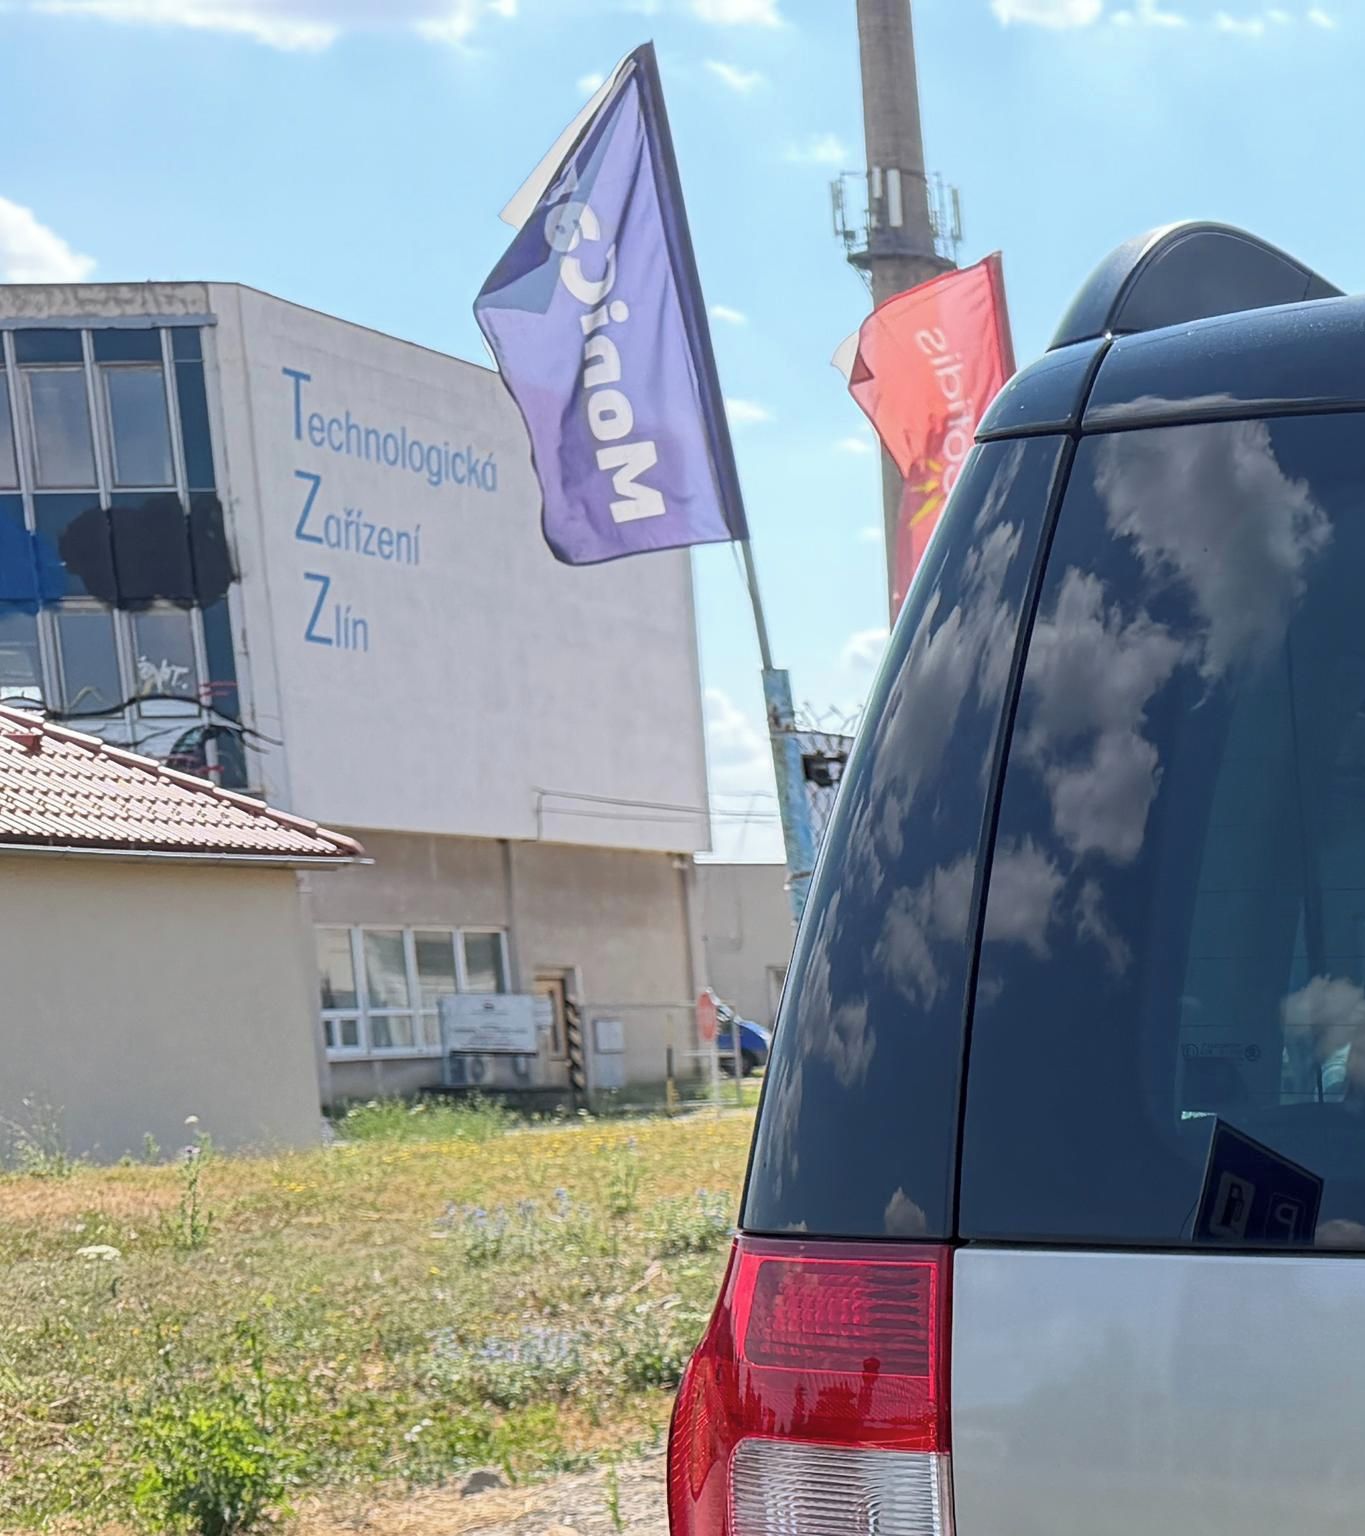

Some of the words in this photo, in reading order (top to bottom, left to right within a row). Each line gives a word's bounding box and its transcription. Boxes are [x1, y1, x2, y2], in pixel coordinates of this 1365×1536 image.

[282, 367, 497, 492] Technologická
[294, 470, 420, 566] Zařízení
[304, 572, 369, 652] Zlín
